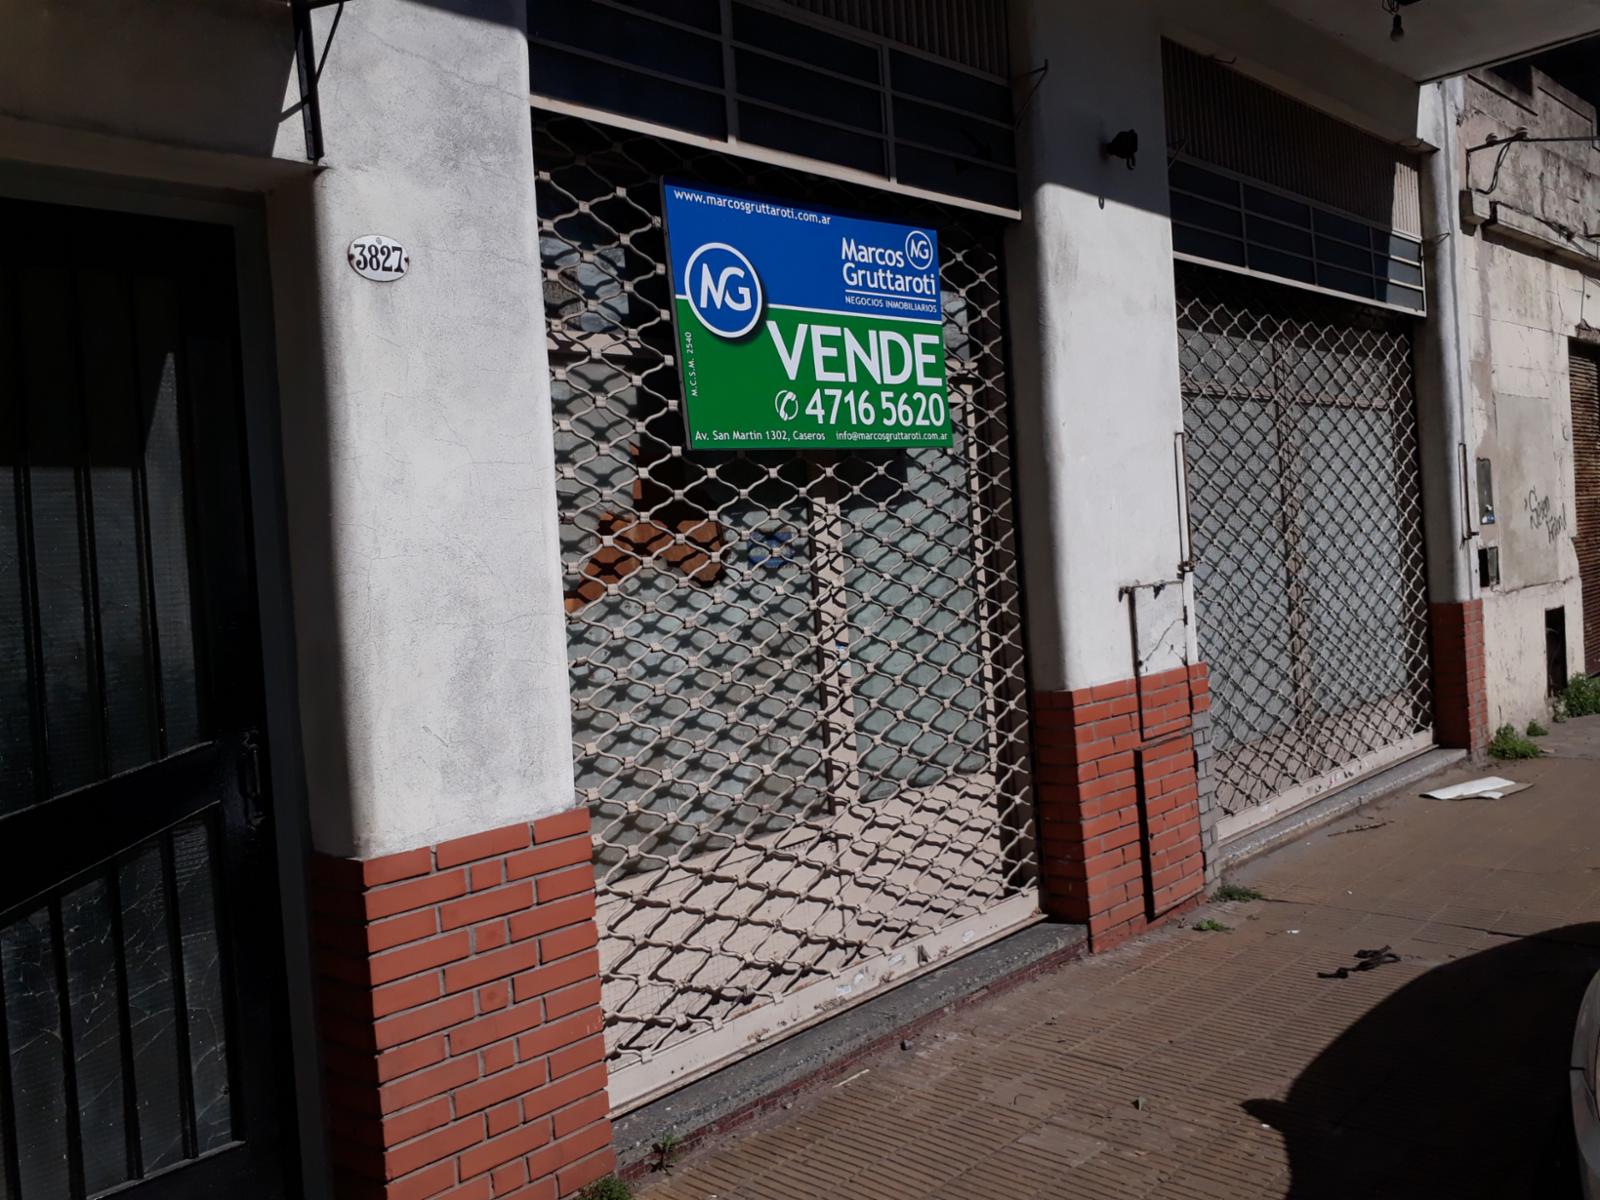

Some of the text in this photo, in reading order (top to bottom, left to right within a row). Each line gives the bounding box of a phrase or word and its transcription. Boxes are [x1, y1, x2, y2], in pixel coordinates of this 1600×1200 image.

[673, 190, 831, 225] www.marcosgruttaroti.com.ar
[353, 243, 404, 273] 3827
[841, 237, 905, 268] Marcos
[842, 262, 936, 296] Gruttaroti
[844, 295, 937, 313] NEGOCIOS INMOBILIARIOS
[684, 331, 694, 354] 2540
[766, 320, 943, 387] VENDE
[805, 388, 945, 427] 4716 5620
[694, 430, 710, 441] Av.
[712, 430, 730, 441] San
[765, 430, 791, 443] 1302,
[792, 430, 826, 441] Caseros
[835, 430, 948, 443] info@marcosgruttaroti.com.ar
